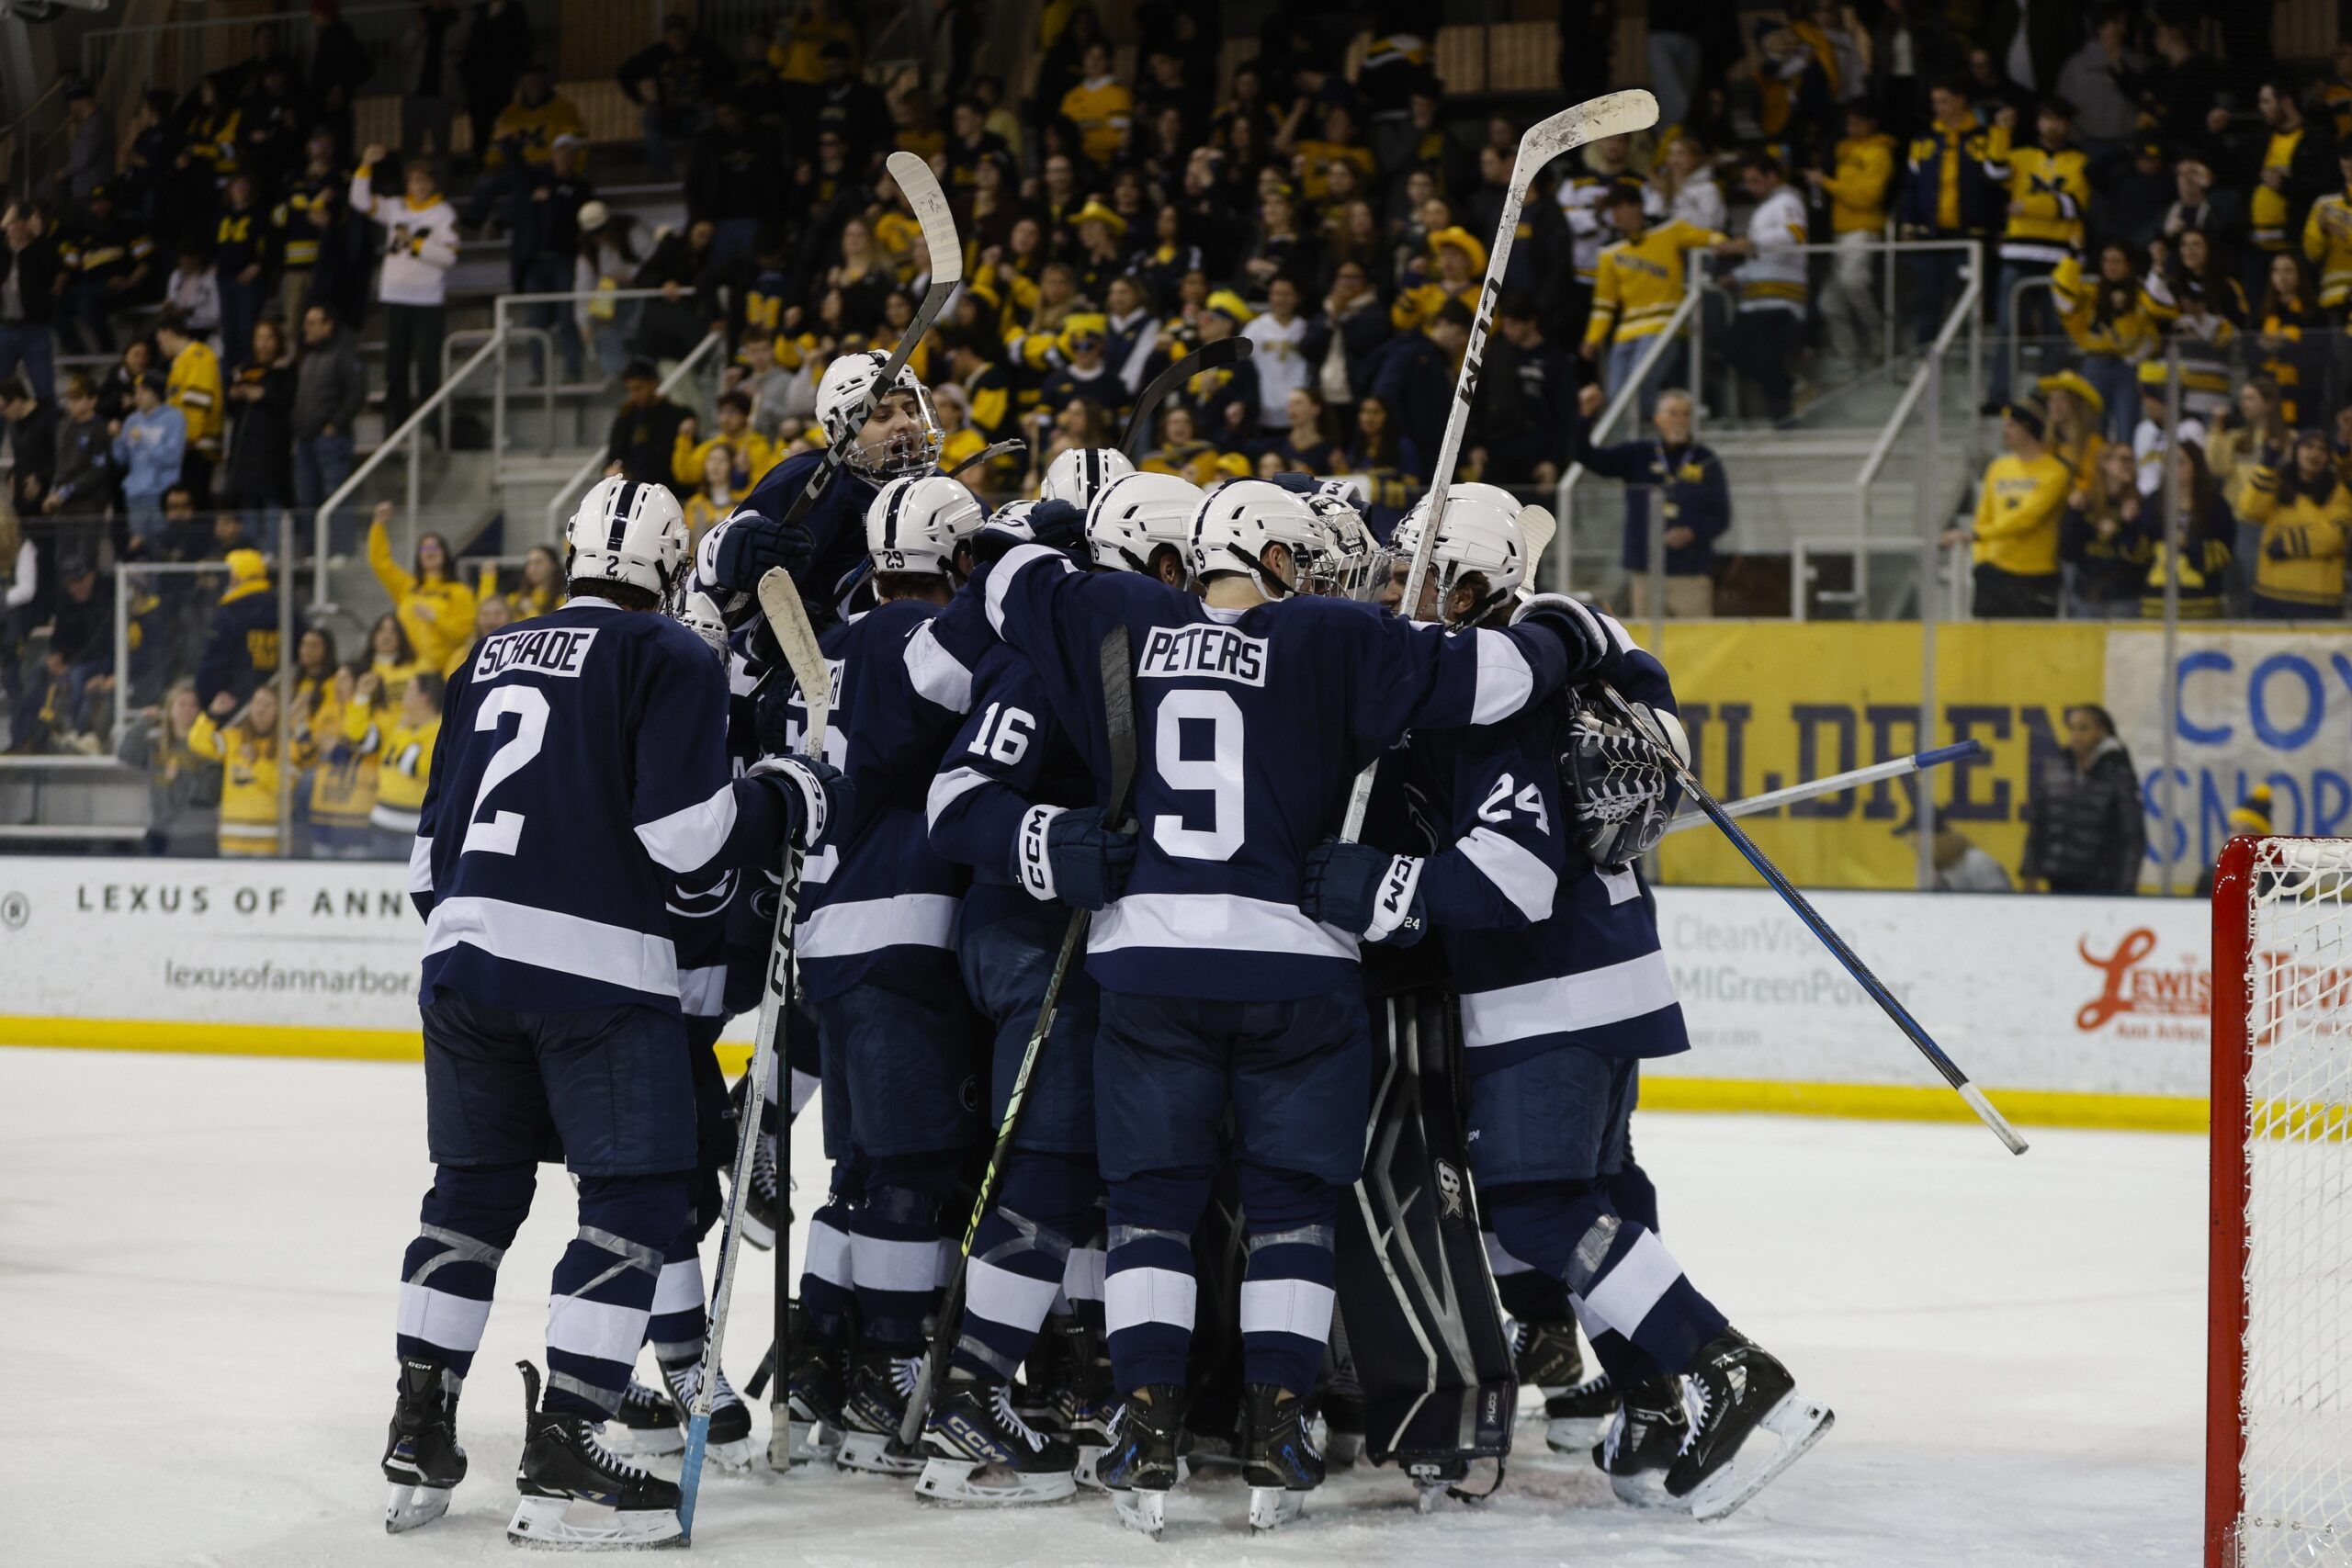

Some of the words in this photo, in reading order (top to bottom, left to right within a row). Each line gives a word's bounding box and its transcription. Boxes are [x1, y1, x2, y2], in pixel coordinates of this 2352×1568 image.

[1458, 276, 1501, 407] CCM
[605, 555, 619, 577] 2
[882, 550, 906, 569] 29
[1194, 547, 1206, 570] 9
[478, 630, 591, 676] SCHADE
[1144, 627, 1263, 681] PETERS
[2176, 649, 2352, 752] CO
[967, 701, 1036, 766] 16
[460, 683, 551, 856] 2
[1155, 689, 1247, 862] 9
[1476, 772, 1552, 837] 24
[1025, 809, 1048, 890] CCM
[76, 884, 209, 914] LEXUS
[234, 886, 287, 915] OF
[311, 888, 402, 918] ANN
[769, 849, 806, 998] CCM
[1403, 916, 1421, 931] 24
[962, 1159, 997, 1258] CCM
[408, 1360, 433, 1371] CCM
[694, 1315, 715, 1396] CCM
[947, 1416, 1009, 1464] CCM
